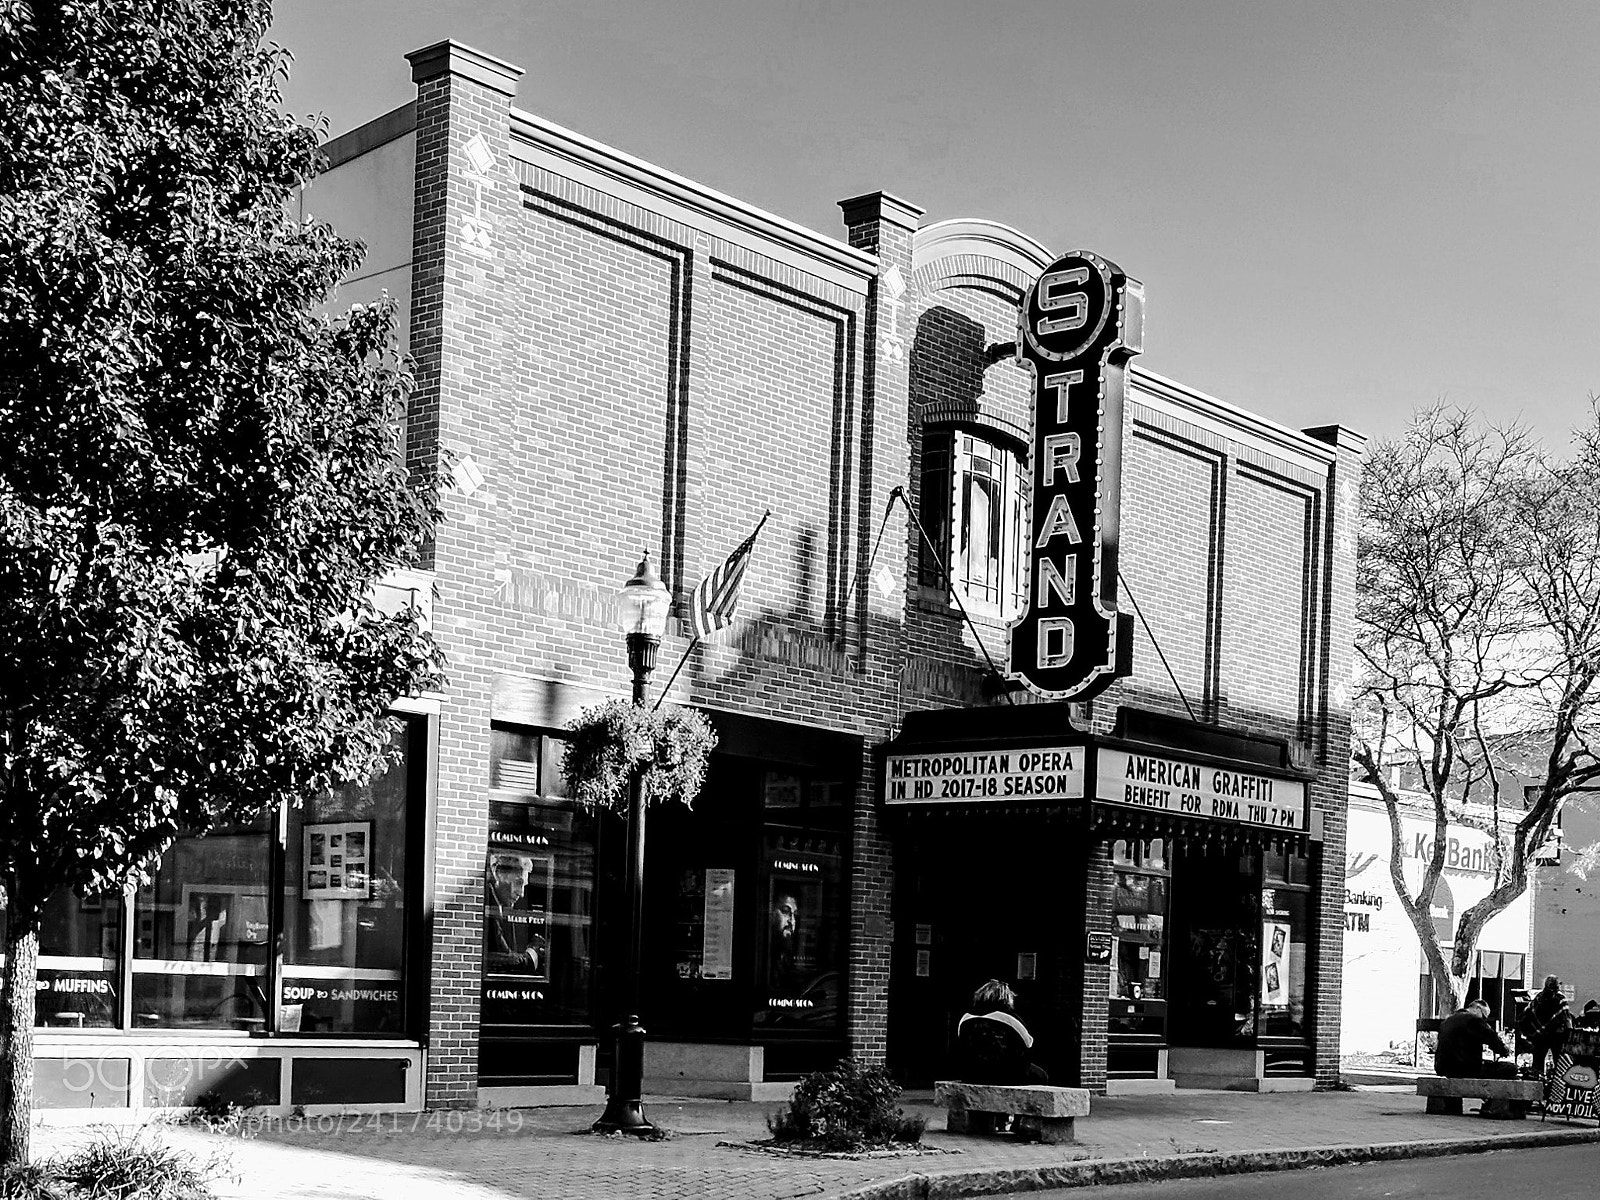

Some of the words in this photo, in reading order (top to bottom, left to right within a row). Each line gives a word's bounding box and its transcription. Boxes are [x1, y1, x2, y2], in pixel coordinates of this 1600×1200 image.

[1036, 266, 1090, 670] STRAND
[891, 755, 1009, 777] METROPOLITAN
[1018, 752, 1073, 772] OPERA
[891, 781, 906, 799] IN
[914, 780, 934, 798] HD
[941, 778, 998, 798] 2017-18
[1004, 775, 1067, 796] SEASON
[1125, 755, 1201, 790] AMERICAN
[1212, 771, 1274, 802] GRAFFITI
[1124, 784, 1171, 808] BENEFIT
[1180, 794, 1202, 813] FOR
[1248, 804, 1267, 823] THU
[1271, 808, 1278, 824] 7
[1280, 809, 1295, 827] PM
[491, 832, 522, 844] COMING
[1414, 832, 1492, 871] KeBank
[1345, 889, 1383, 911] Banking
[54, 978, 109, 993] MUFFINS
[283, 986, 315, 999] SOUP
[317, 989, 329, 999] to
[331, 988, 399, 1001] SANDWICHES
[486, 990, 520, 1000] COMING
[1566, 1088, 1593, 1104] LIVE
